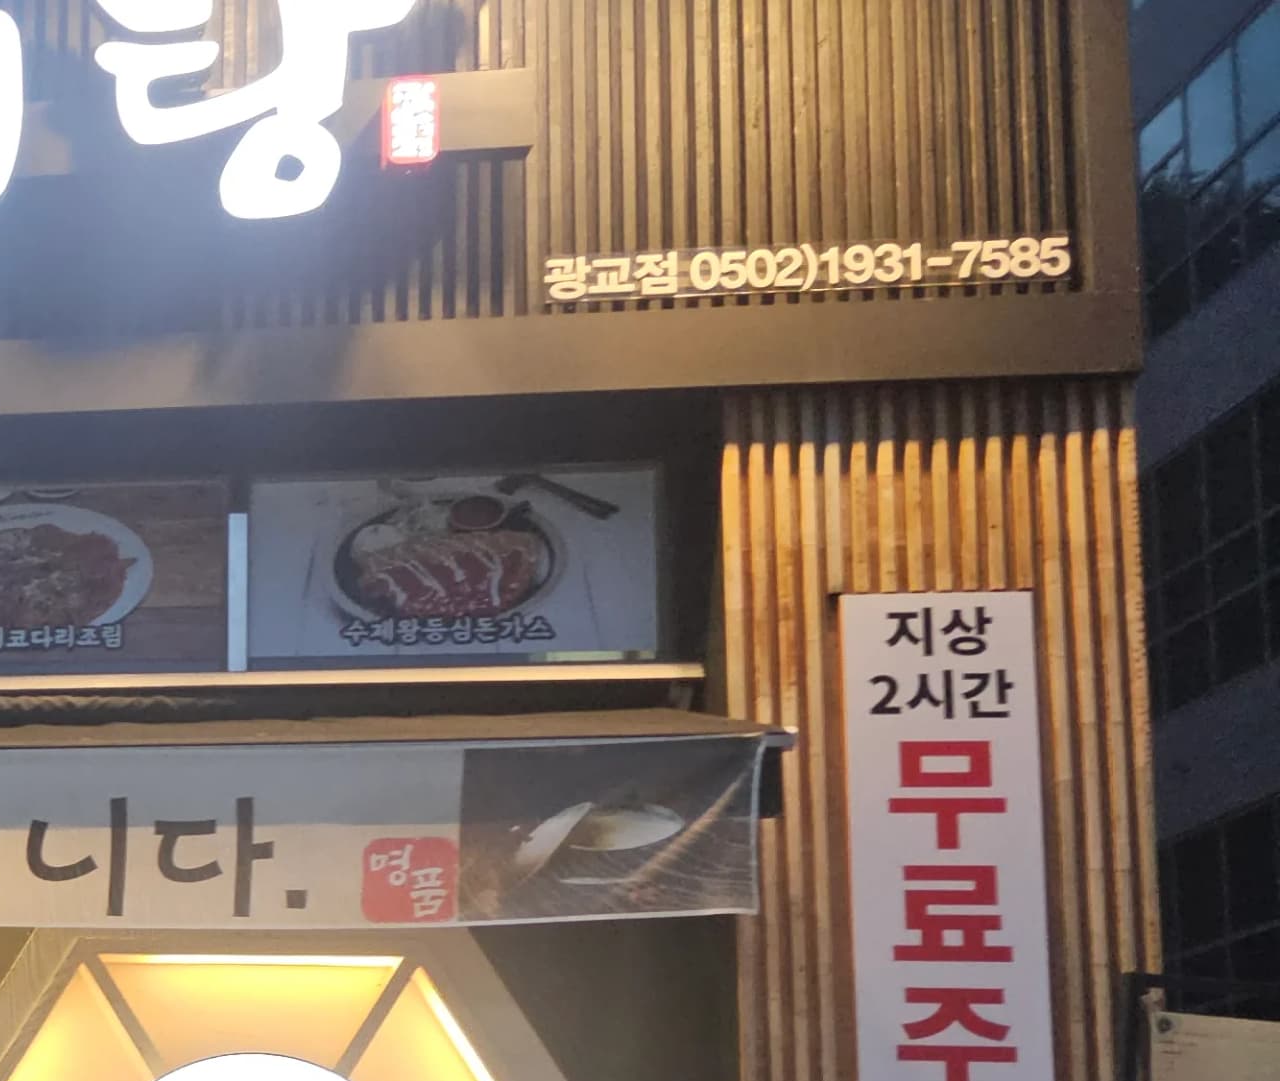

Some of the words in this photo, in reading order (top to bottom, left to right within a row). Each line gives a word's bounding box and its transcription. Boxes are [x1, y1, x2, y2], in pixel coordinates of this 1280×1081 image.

[543, 249, 678, 301] 광교점
[690, 236, 1072, 294] 0502)1931-7585
[341, 615, 556, 647] 수제왕등심돈가스
[884, 605, 993, 658] 지상
[867, 669, 1015, 720] 2시간
[368, 843, 448, 918] 명품
